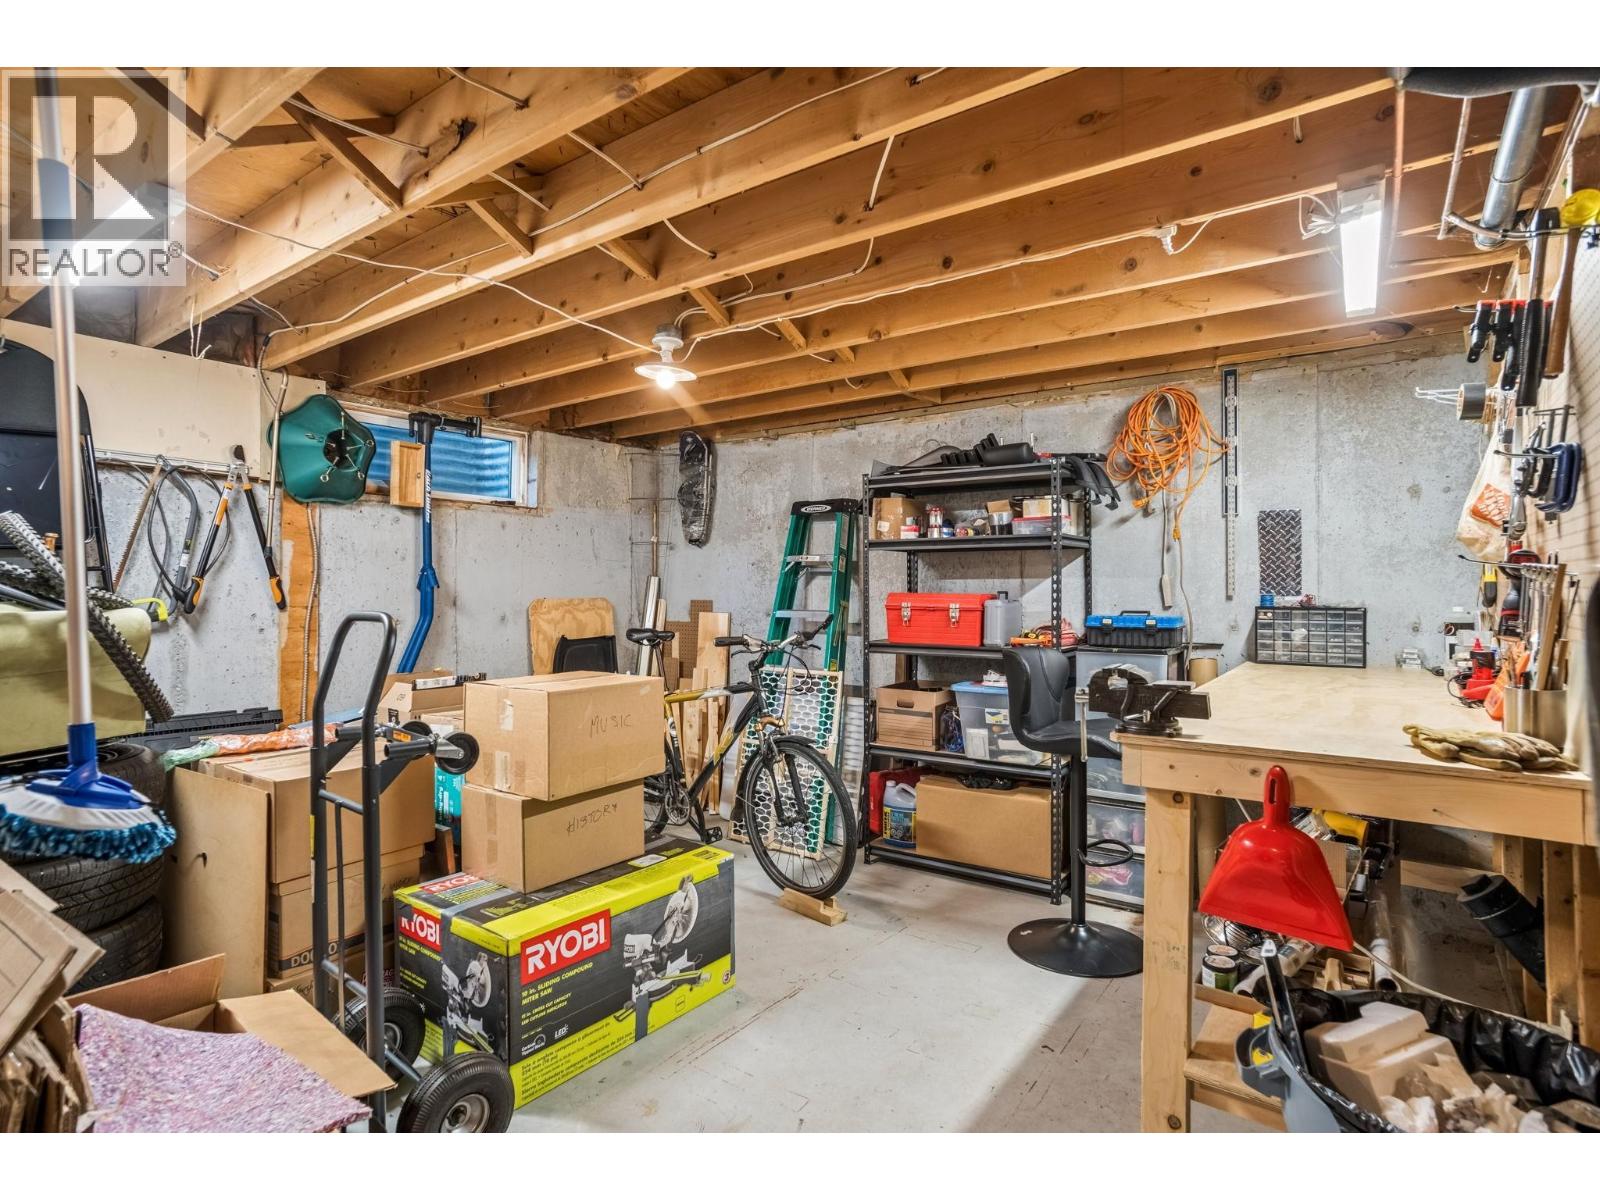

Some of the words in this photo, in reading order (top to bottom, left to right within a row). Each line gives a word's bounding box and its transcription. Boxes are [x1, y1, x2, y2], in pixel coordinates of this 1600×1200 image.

[590, 714, 632, 738] MUSIC
[567, 803, 617, 837] HISTORY
[525, 918, 605, 975] RYOBI
[538, 976, 560, 991] SLIDING
[561, 962, 593, 980] COMPOUND
[522, 993, 539, 1006] MITER
[540, 987, 553, 998] SAW
[554, 1026, 566, 1039] LED
